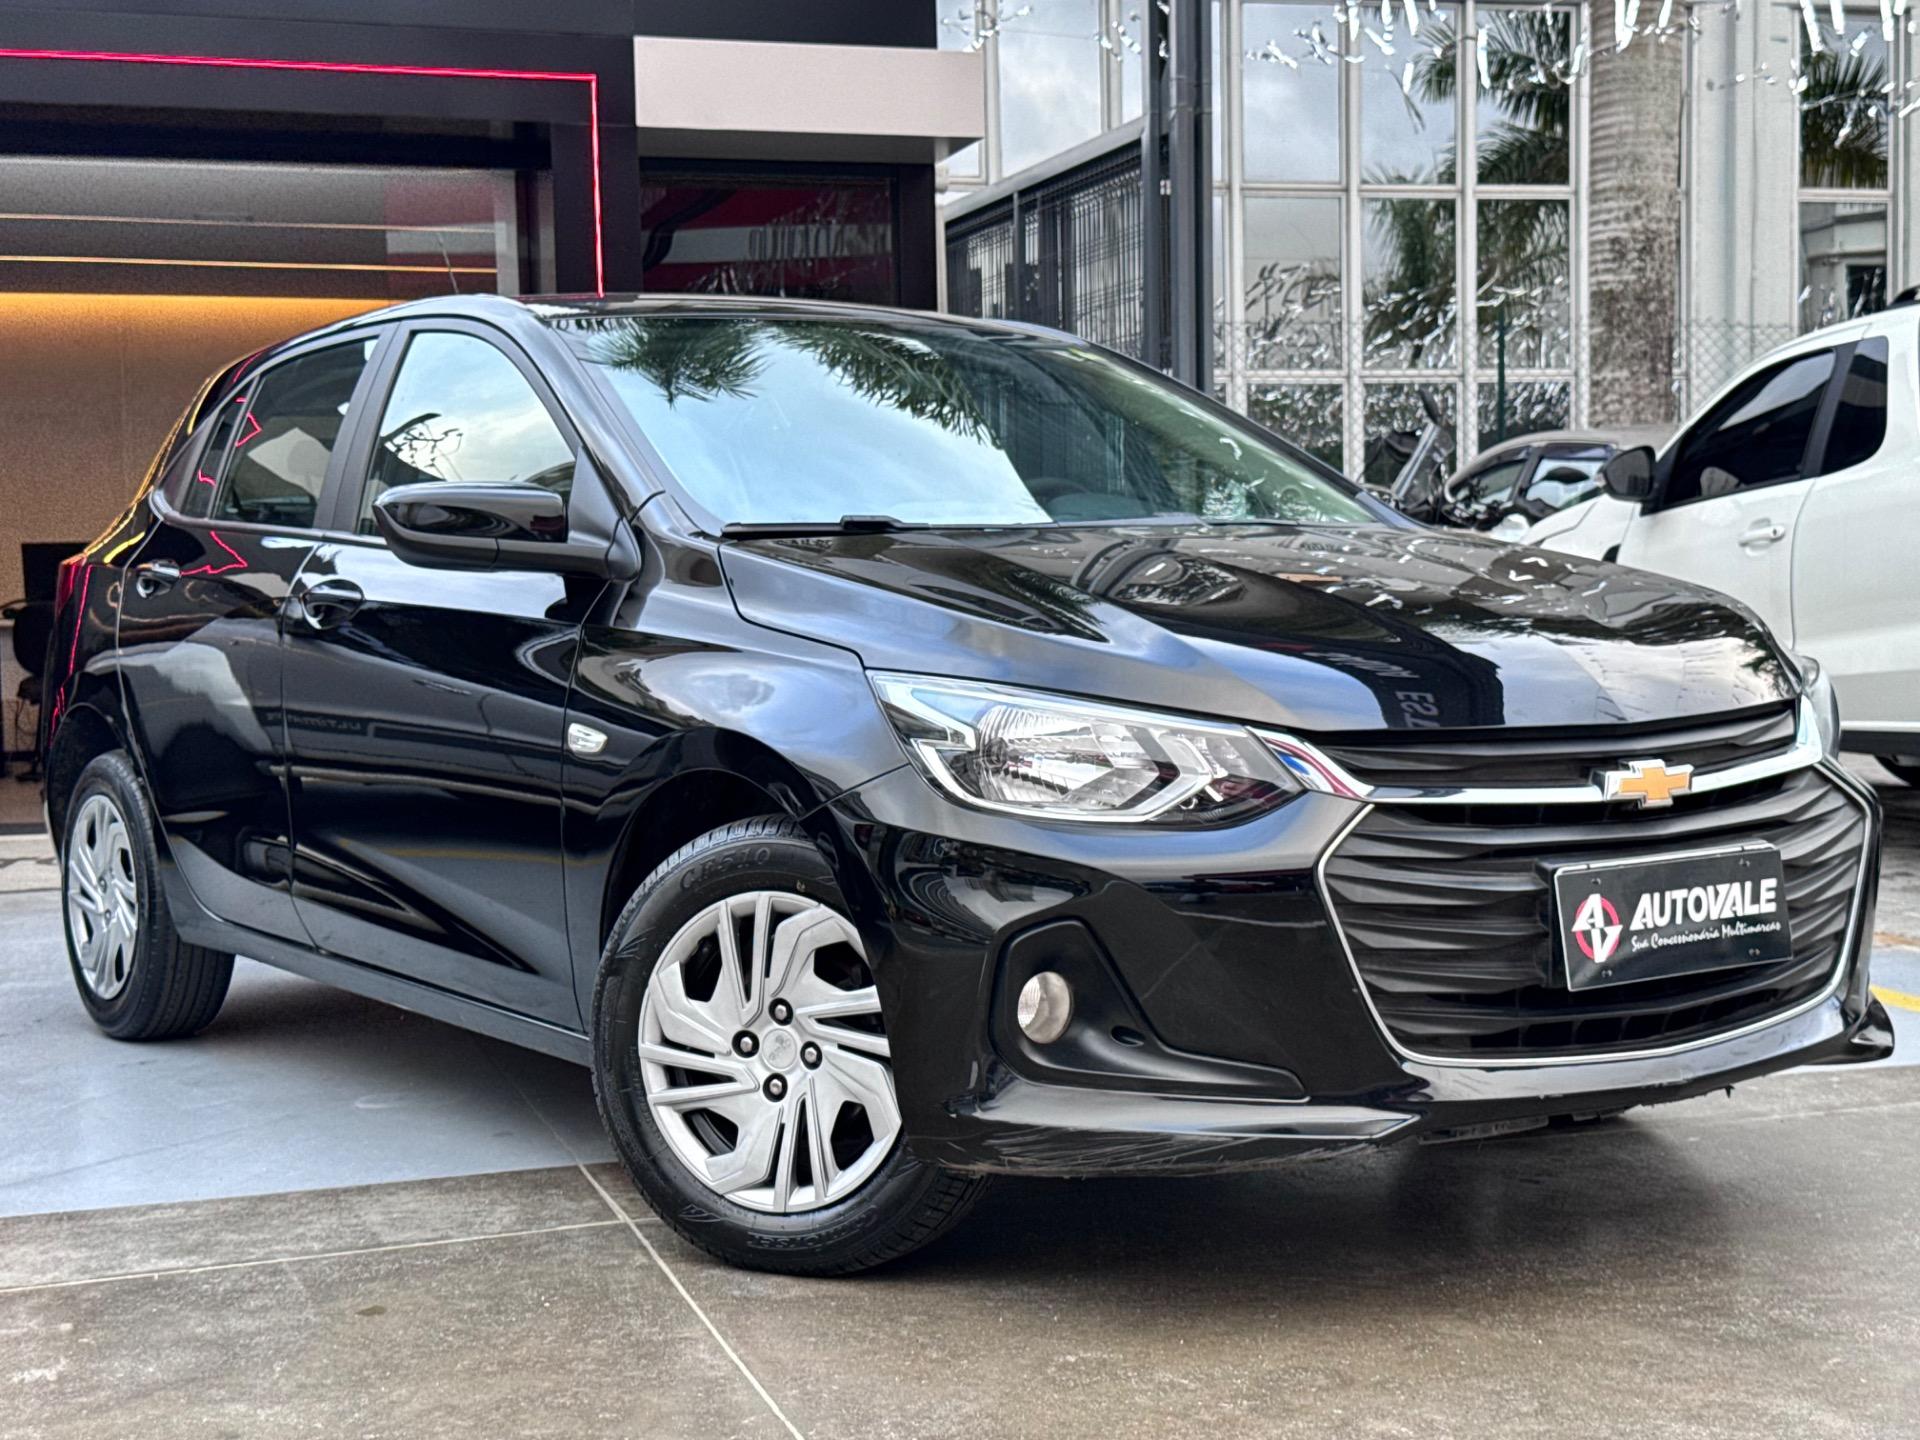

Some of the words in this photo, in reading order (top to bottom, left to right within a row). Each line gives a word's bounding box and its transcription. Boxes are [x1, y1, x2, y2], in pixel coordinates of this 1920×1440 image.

[1629, 878, 1778, 931] AUTOVALE
[1631, 935, 1650, 952] Sua
[1721, 921, 1781, 939] Multimarcas
